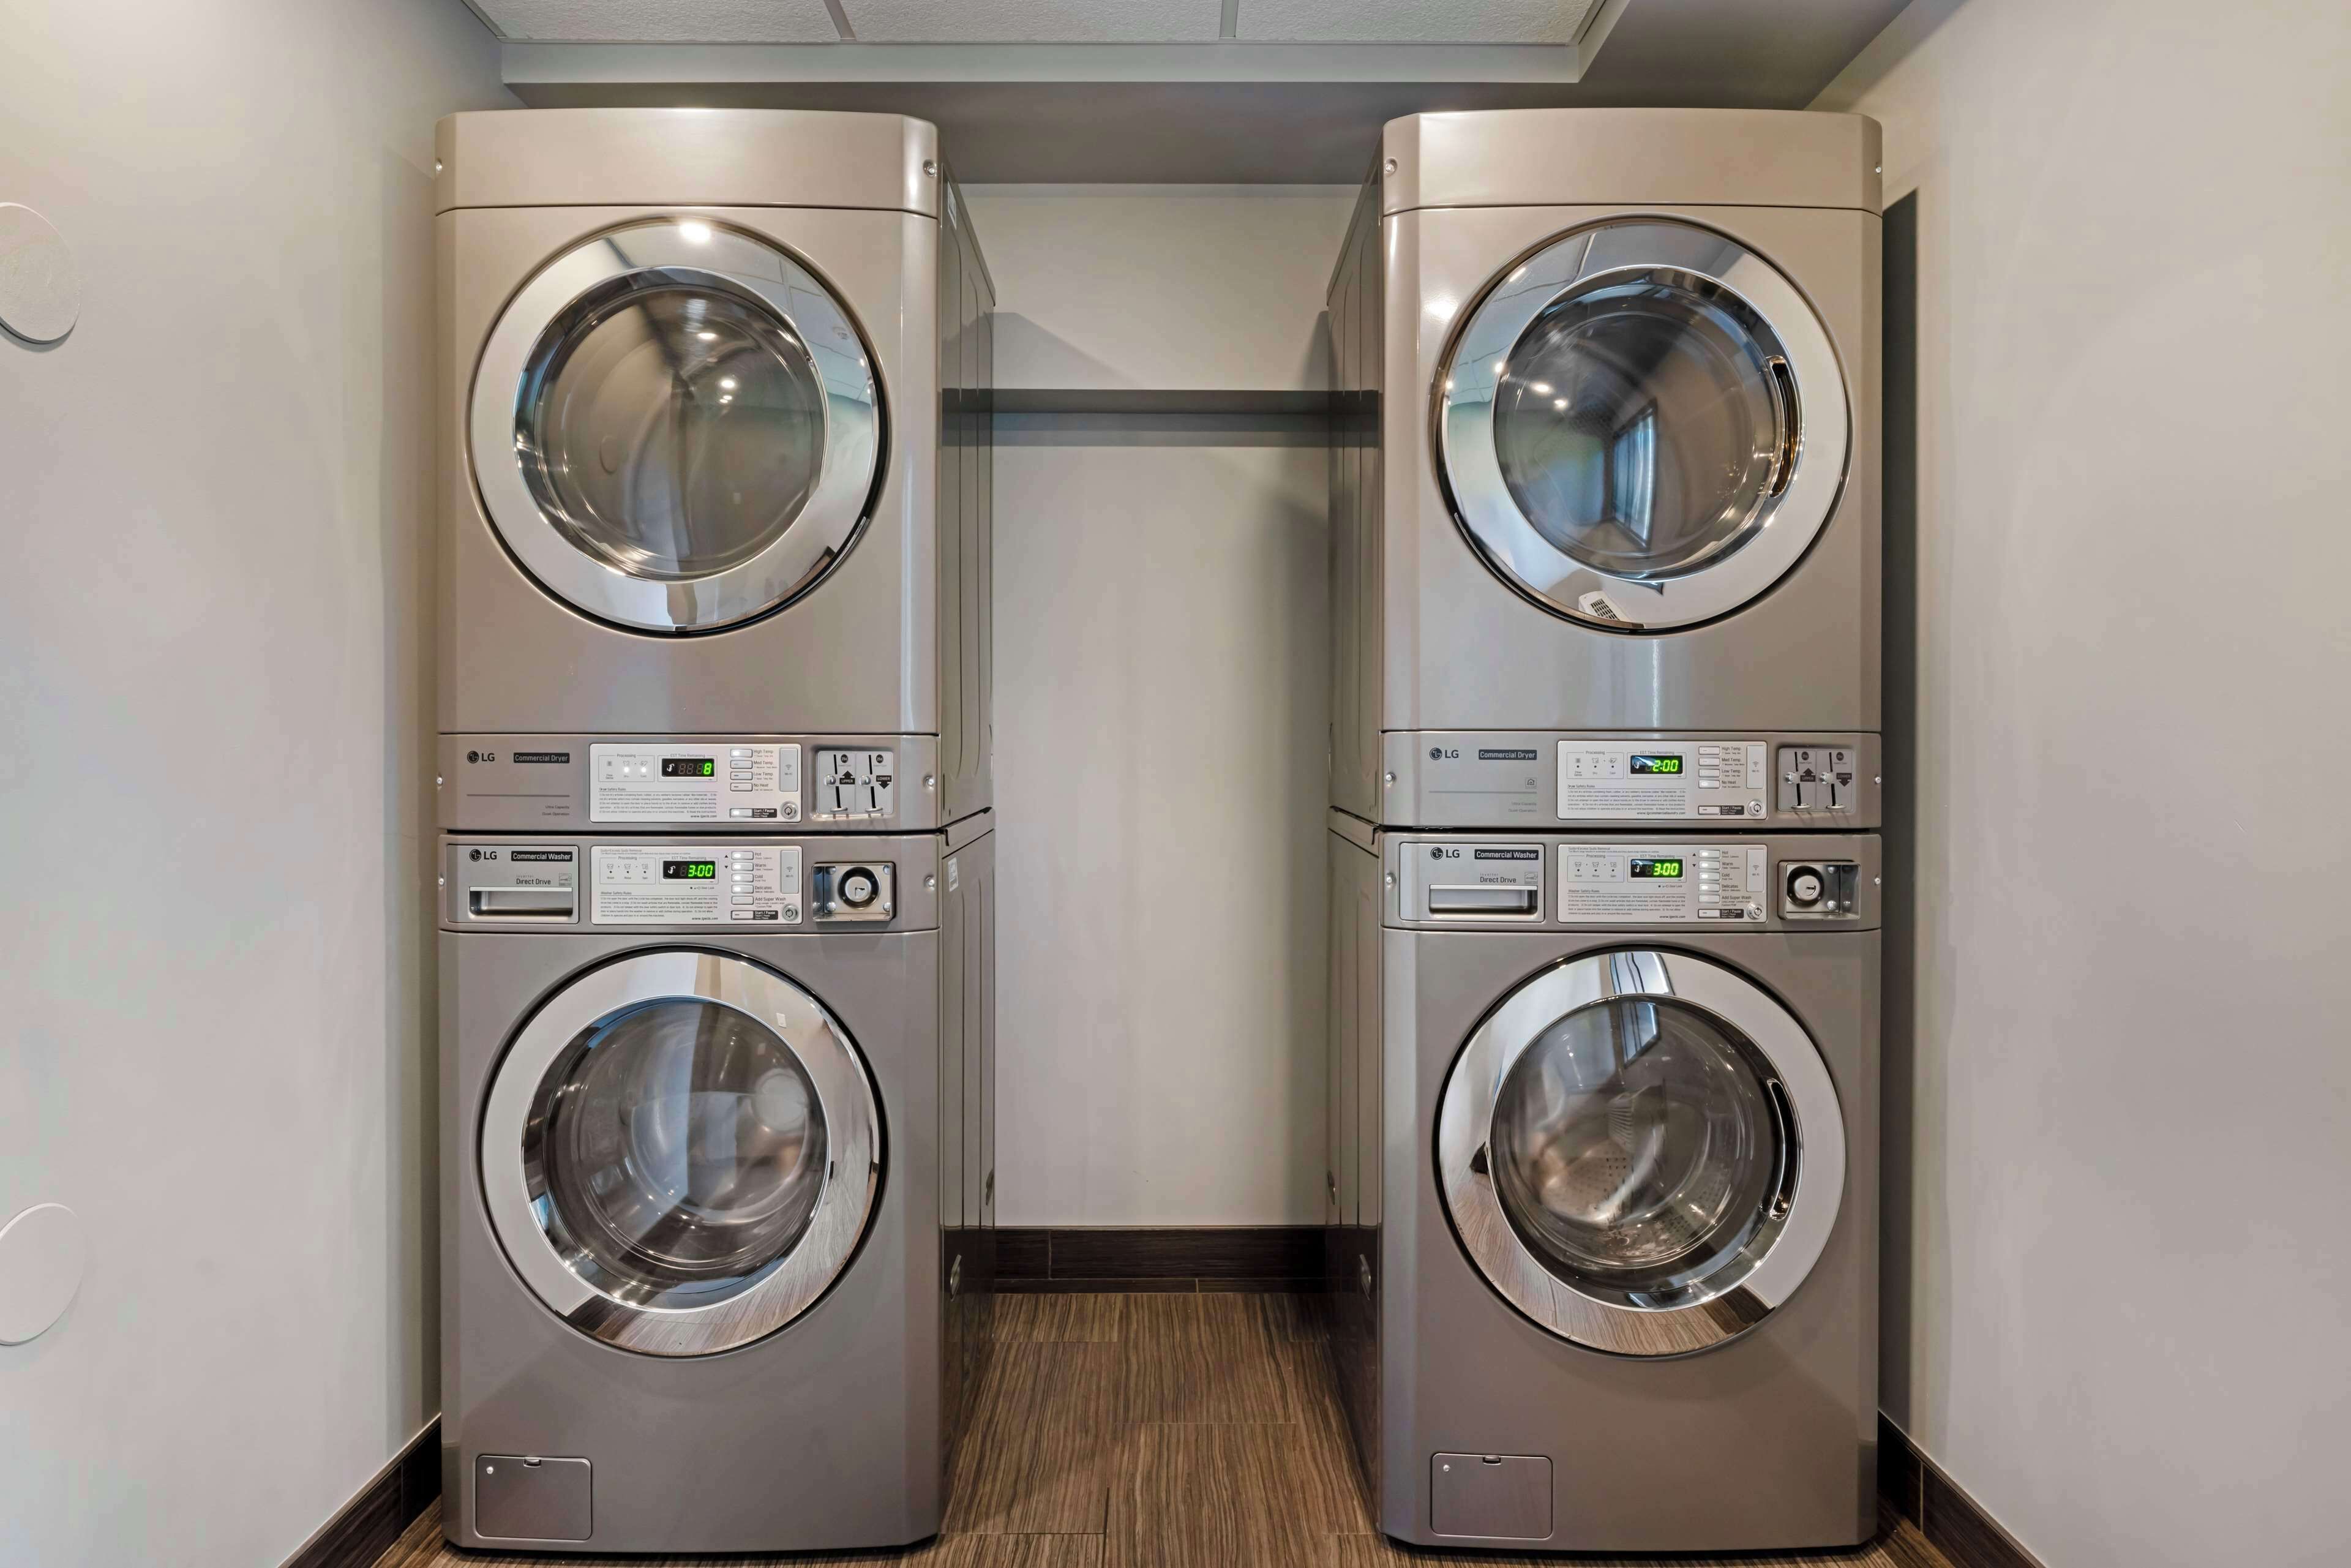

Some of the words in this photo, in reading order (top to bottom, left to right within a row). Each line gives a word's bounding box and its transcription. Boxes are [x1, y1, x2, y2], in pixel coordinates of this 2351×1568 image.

[481, 752, 495, 762] LG
[1444, 749, 1459, 759] LG
[484, 851, 497, 860] LG
[1445, 849, 1460, 858] LG
